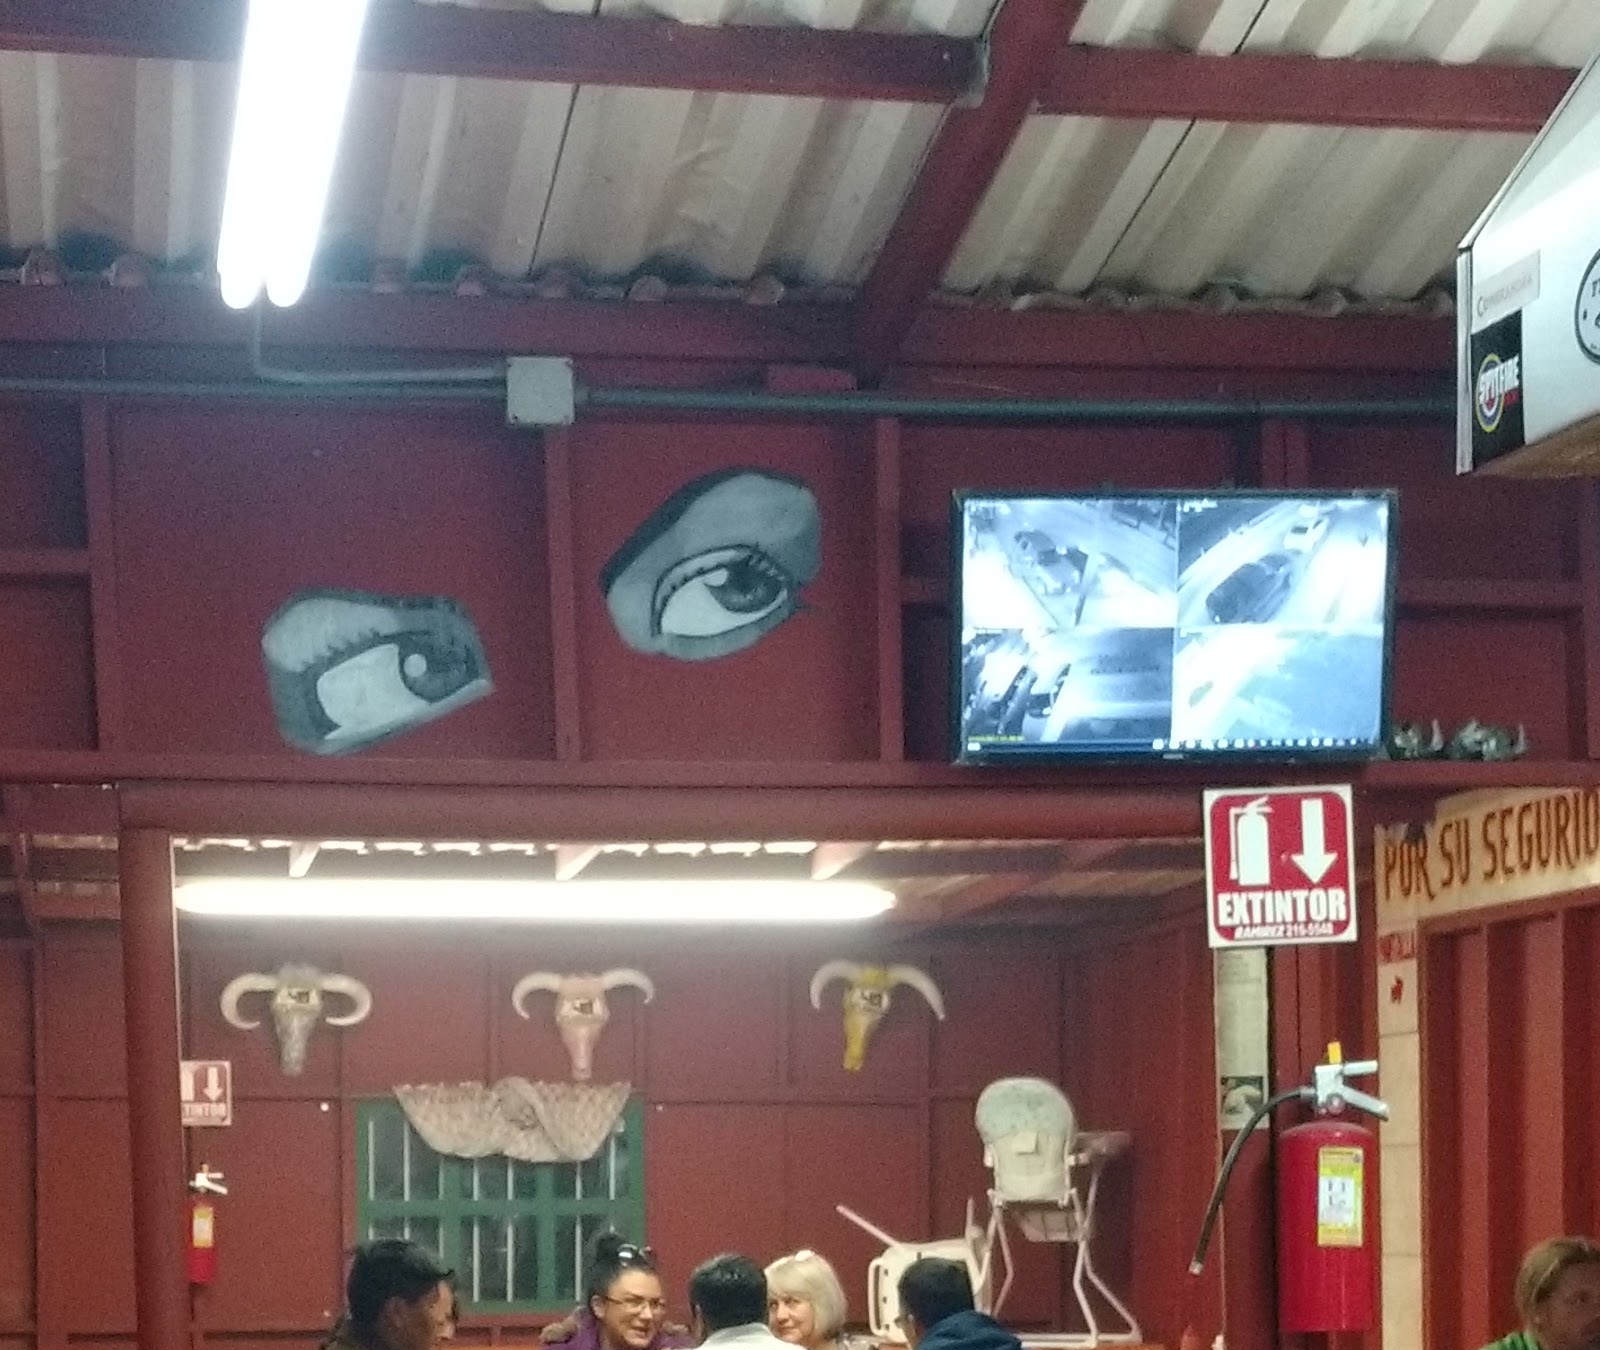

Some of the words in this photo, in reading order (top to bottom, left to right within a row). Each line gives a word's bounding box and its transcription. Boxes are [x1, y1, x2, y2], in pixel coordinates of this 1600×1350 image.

[1383, 838, 1436, 901] POR
[1438, 817, 1471, 890] SU
[1217, 886, 1347, 927] EXTINTOR
